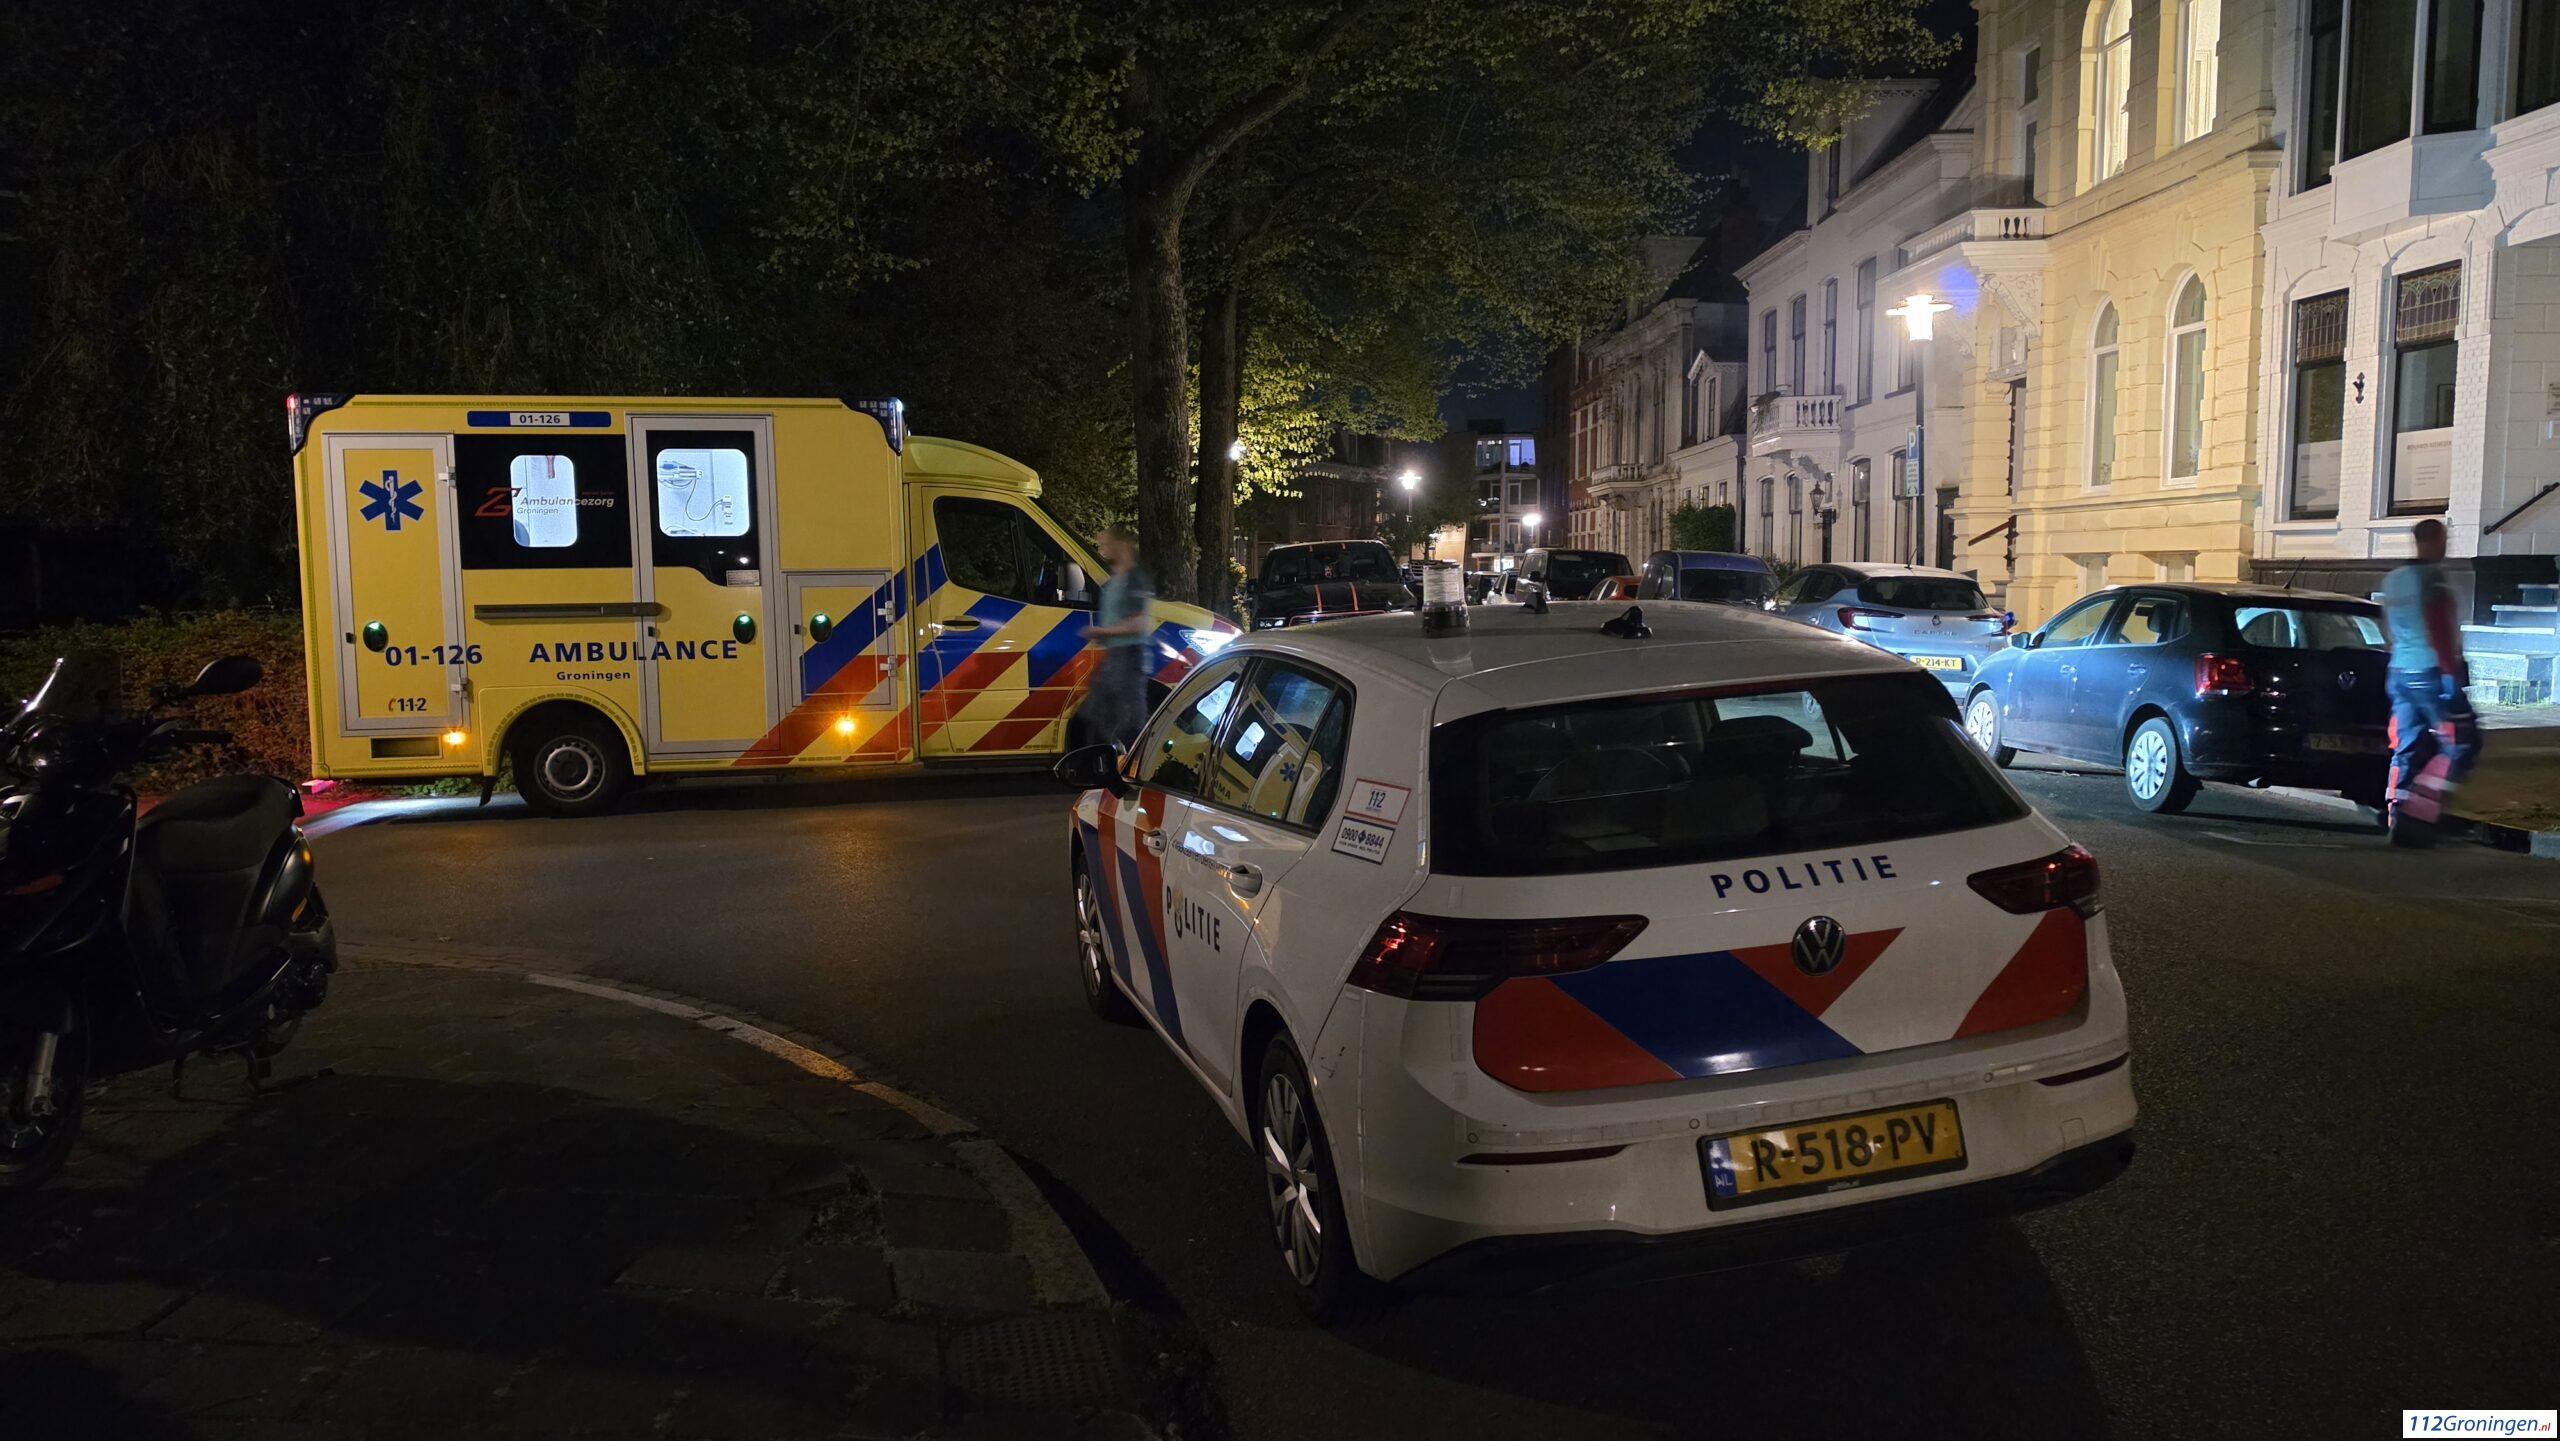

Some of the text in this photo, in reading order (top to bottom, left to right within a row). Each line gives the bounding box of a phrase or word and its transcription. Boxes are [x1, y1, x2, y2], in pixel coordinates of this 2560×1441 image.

[519, 414, 561, 424] 01-126
[1908, 431, 1916, 457] P
[516, 507, 559, 515] Groningen
[520, 496, 615, 507] Ambulancezorg
[385, 644, 483, 667] 01-126
[529, 639, 738, 663] AMBULANCE
[556, 670, 631, 681] Groningen
[1710, 855, 1898, 899] POLITIE
[1166, 885, 1220, 953] POLITIE
[1751, 1112, 1935, 1183] R-518-PV
[1713, 1174, 1733, 1188] NL
